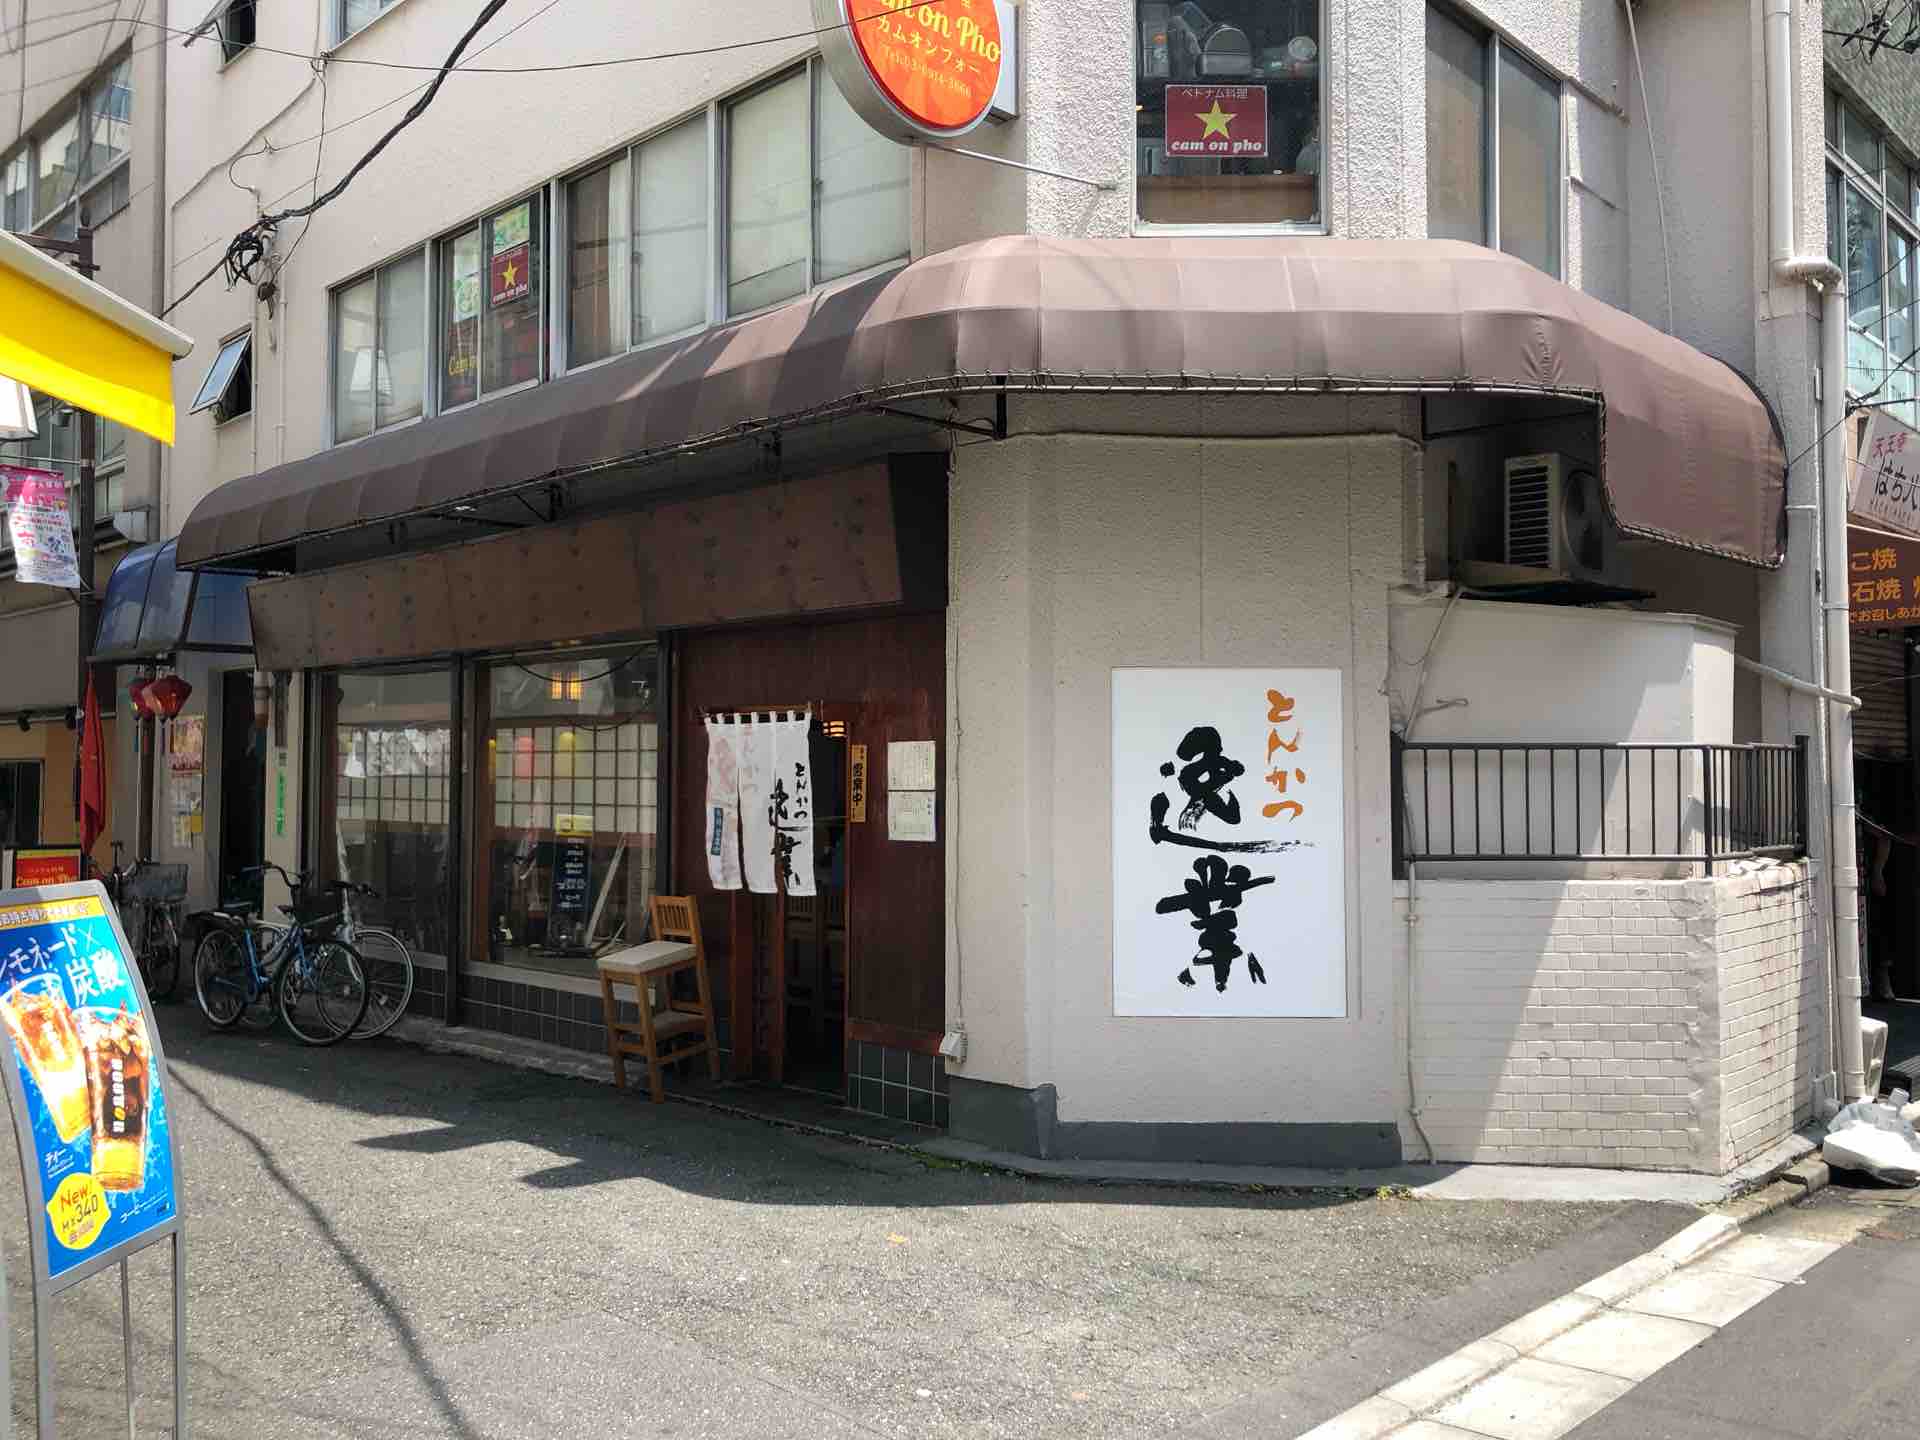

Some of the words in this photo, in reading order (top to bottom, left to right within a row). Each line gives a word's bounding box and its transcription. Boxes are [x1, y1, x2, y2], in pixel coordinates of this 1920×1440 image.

[877, 14, 981, 74] カムオンフォー
[956, 16, 1001, 63] Pho
[1181, 87, 1249, 100] ベトナム料理
[1171, 140, 1204, 151] cam
[1208, 140, 1229, 151] on
[1232, 139, 1263, 154] pho
[1262, 688, 1306, 823] とんかつ
[793, 762, 809, 820] とんかつ
